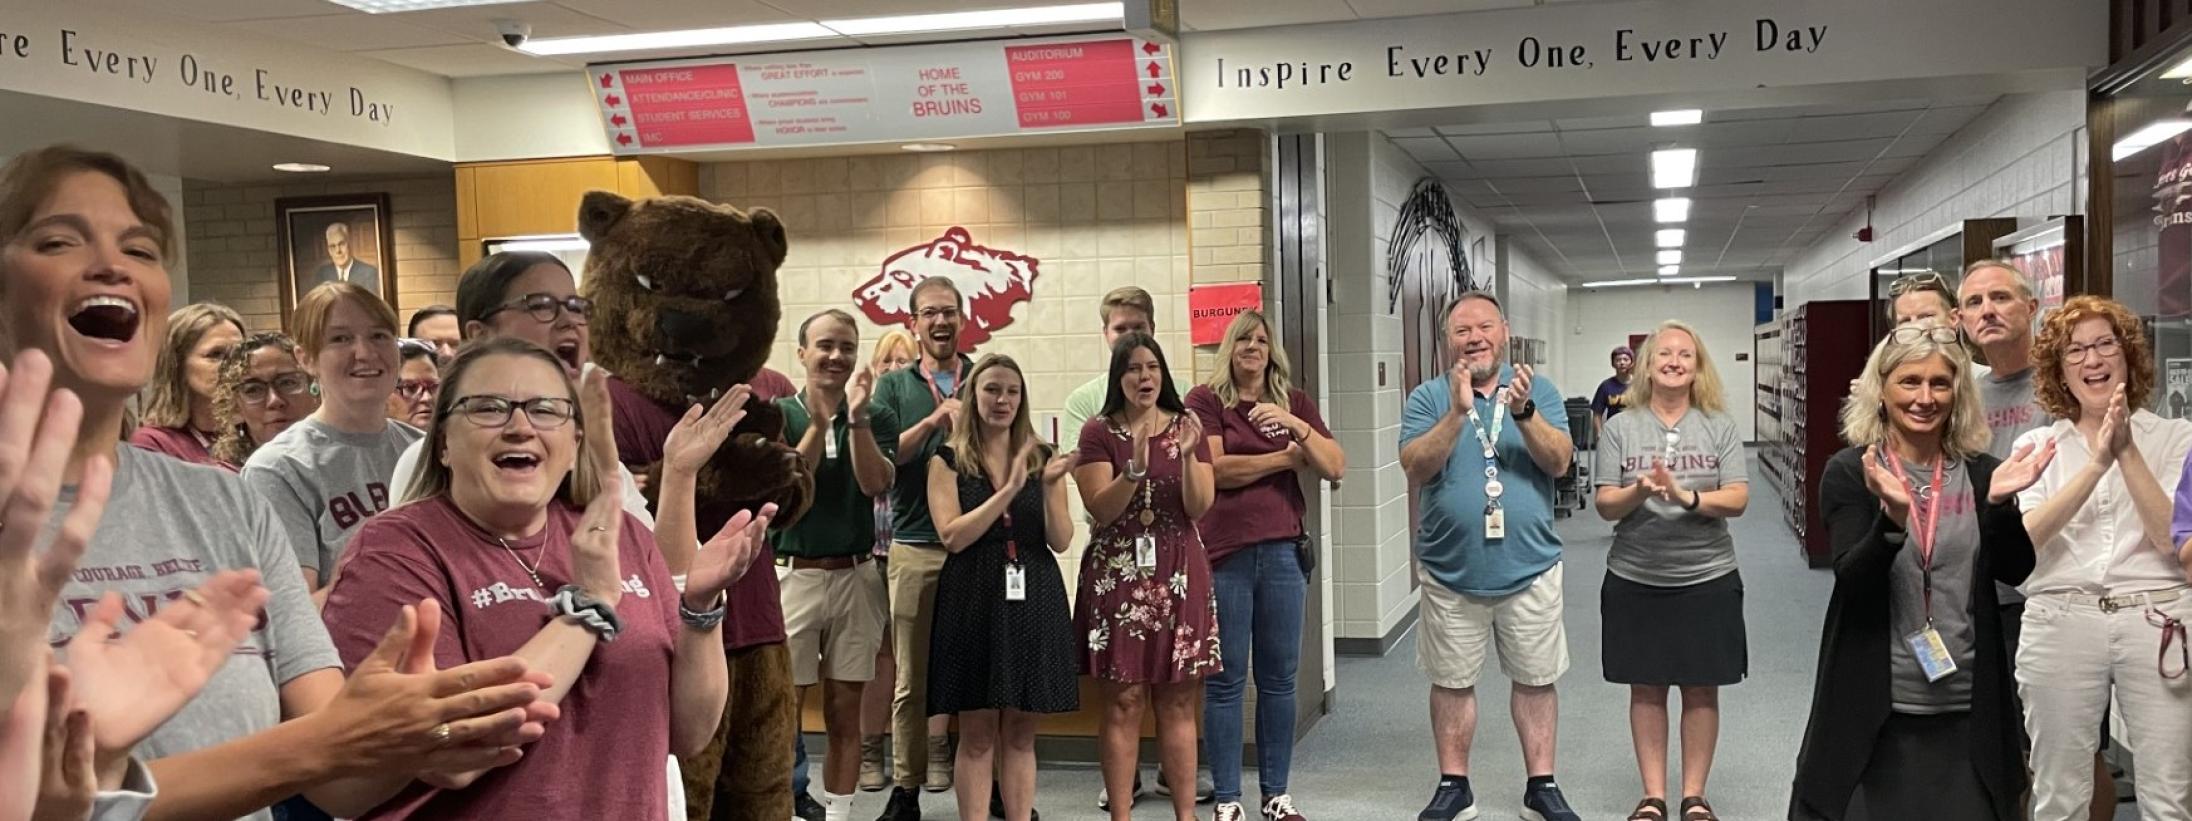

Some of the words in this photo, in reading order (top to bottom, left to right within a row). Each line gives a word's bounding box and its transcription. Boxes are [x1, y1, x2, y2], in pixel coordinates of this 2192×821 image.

[1012, 47, 1084, 61] AUDITORIUM
[1216, 58, 1353, 89] Inspire
[1386, 45, 1493, 78] Every
[1518, 36, 1594, 69] One,
[1615, 28, 1728, 62] Every
[1756, 18, 1828, 54] Day
[60, 29, 158, 84] Every
[180, 54, 241, 101] One,
[255, 68, 333, 116] Every
[349, 86, 394, 127] Day
[625, 73, 654, 84] MAIN
[654, 70, 694, 82] OFFICE
[919, 67, 960, 81] HOME
[1015, 71, 1041, 82] GYM
[918, 85, 937, 97] OF
[940, 83, 969, 95] THE
[1019, 90, 1046, 102] GYM
[912, 97, 983, 117] BRUINS
[637, 110, 685, 123] STUDENT
[687, 107, 741, 120] SERVICES
[1023, 110, 1049, 121] GYM
